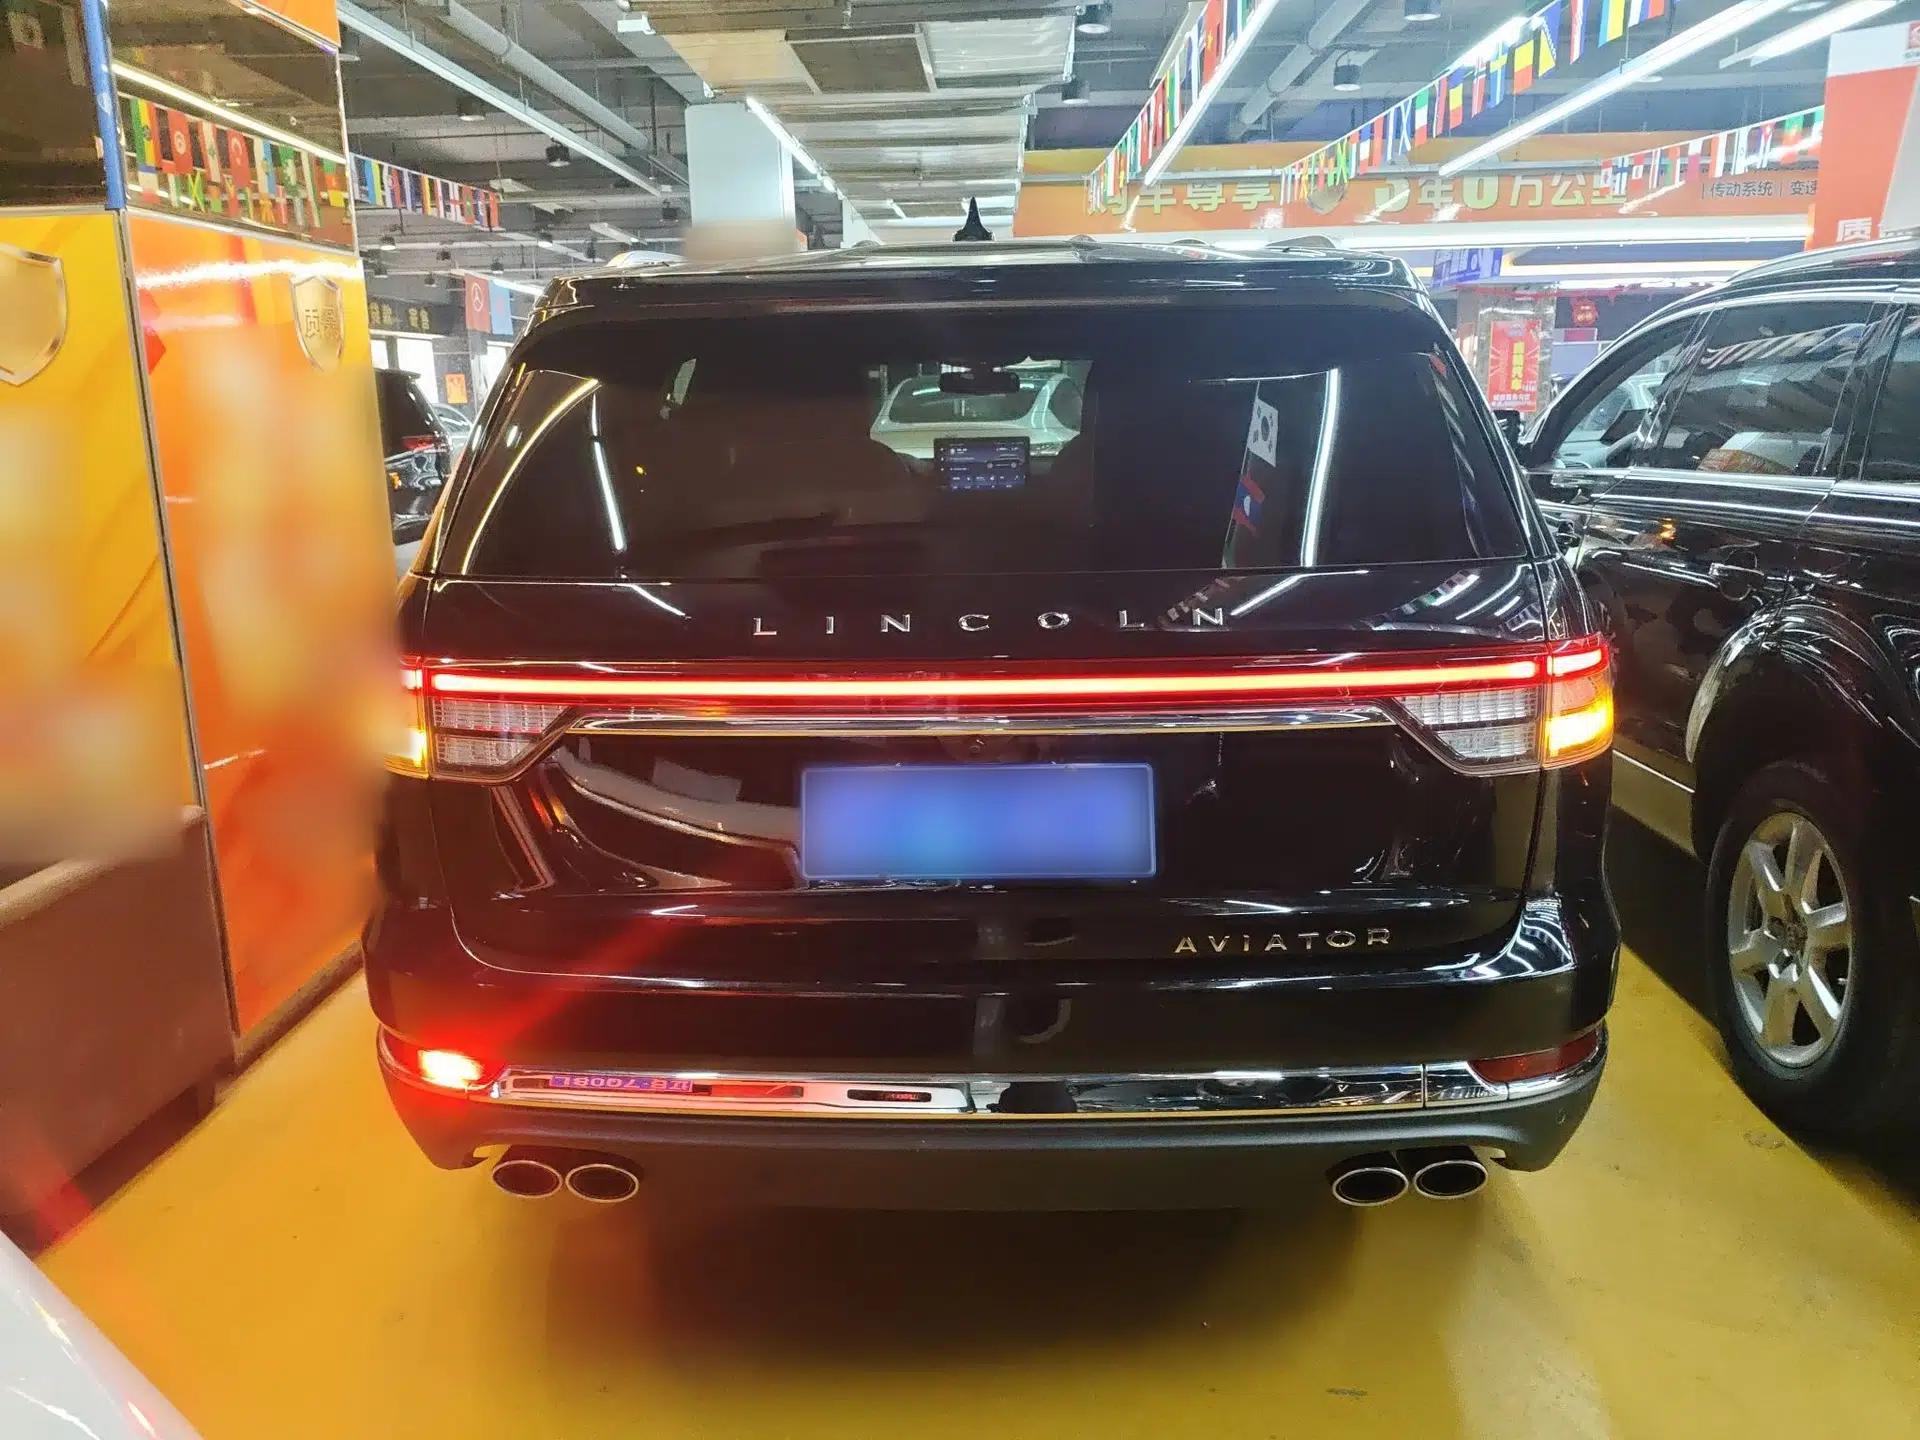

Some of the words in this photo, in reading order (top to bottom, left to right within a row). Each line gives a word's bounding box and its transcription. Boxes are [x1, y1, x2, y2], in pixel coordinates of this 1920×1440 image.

[1711, 180, 1773, 198] 传动系统
[1836, 216, 1872, 242] 质
[752, 606, 1224, 637] LINCOLN
[1174, 928, 1392, 953] AVIATOR
